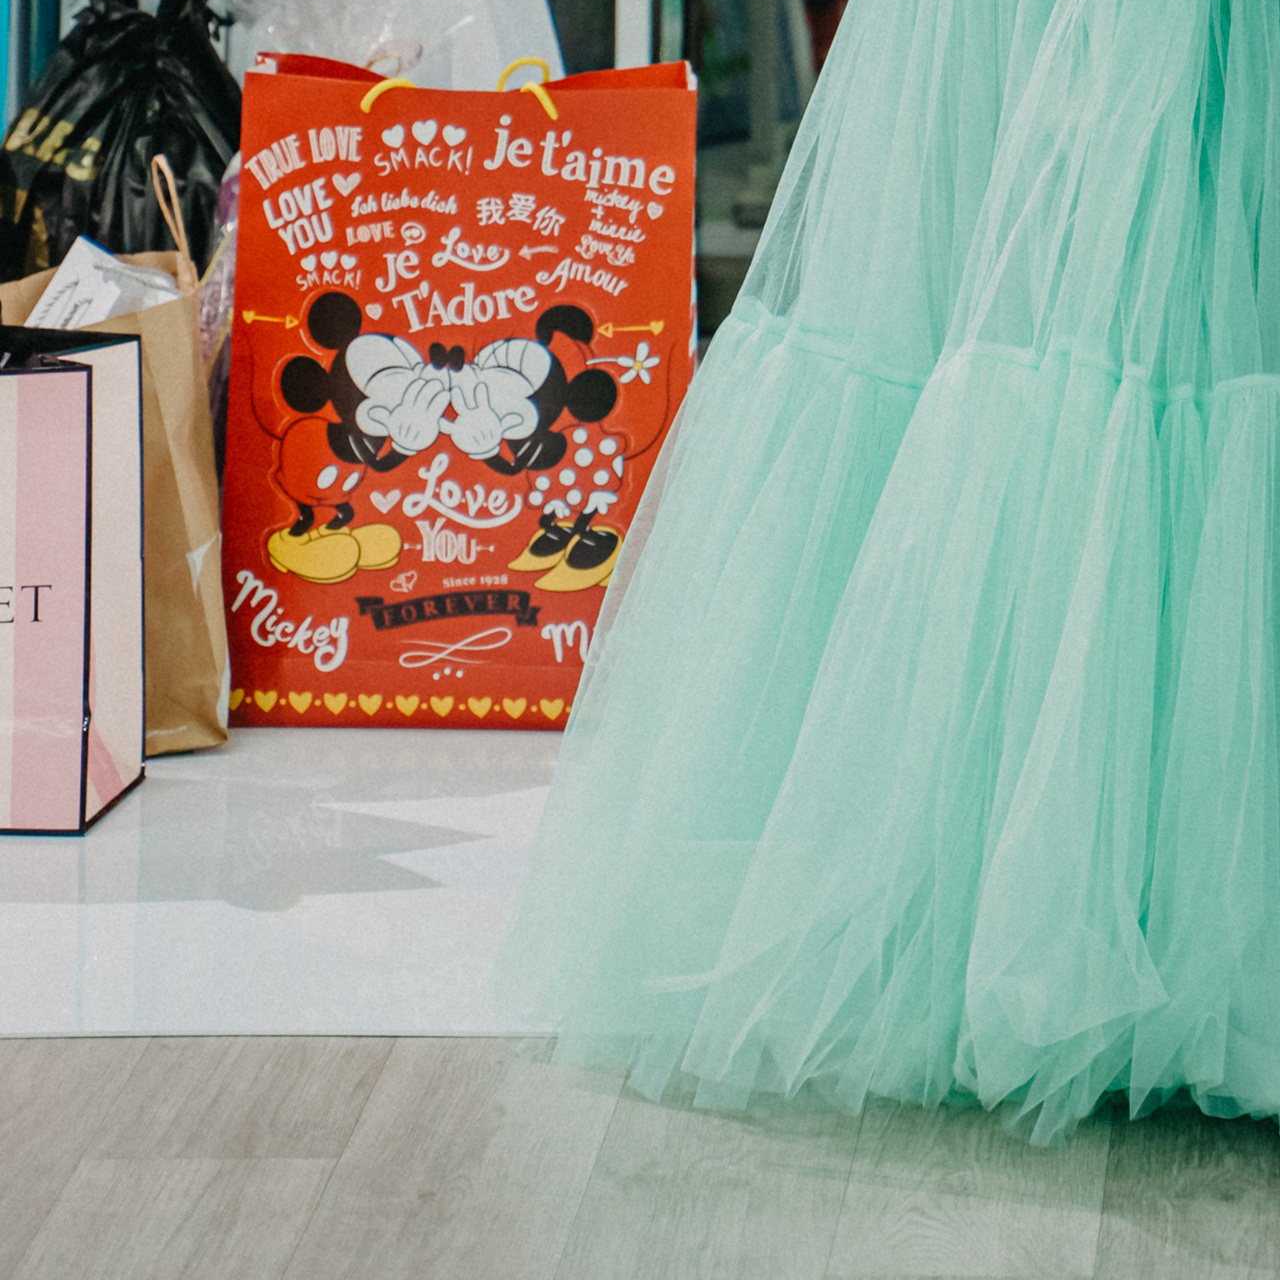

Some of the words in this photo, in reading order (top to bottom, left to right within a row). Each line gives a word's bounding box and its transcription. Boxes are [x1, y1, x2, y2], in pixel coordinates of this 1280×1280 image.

[244, 133, 306, 190] TRUE
[307, 126, 363, 164] LOVE
[374, 145, 474, 176] SMACK!
[483, 114, 533, 170] je
[540, 130, 676, 195] t'aime
[262, 177, 334, 230] LOVE
[351, 194, 378, 218] Ich
[381, 188, 419, 212] liebe
[420, 189, 458, 215] dich
[476, 192, 566, 237] 我爱你
[277, 211, 333, 256] YOU
[345, 221, 395, 246] LOVE
[432, 226, 511, 272] Love
[296, 269, 362, 291] SMACK!
[535, 257, 629, 297] Amour
[392, 280, 539, 333] T'Adore
[402, 452, 523, 529] Love
[480, 574, 509, 587] 1928
[231, 569, 349, 672] Mickey
[384, 592, 523, 627] FOREVER
